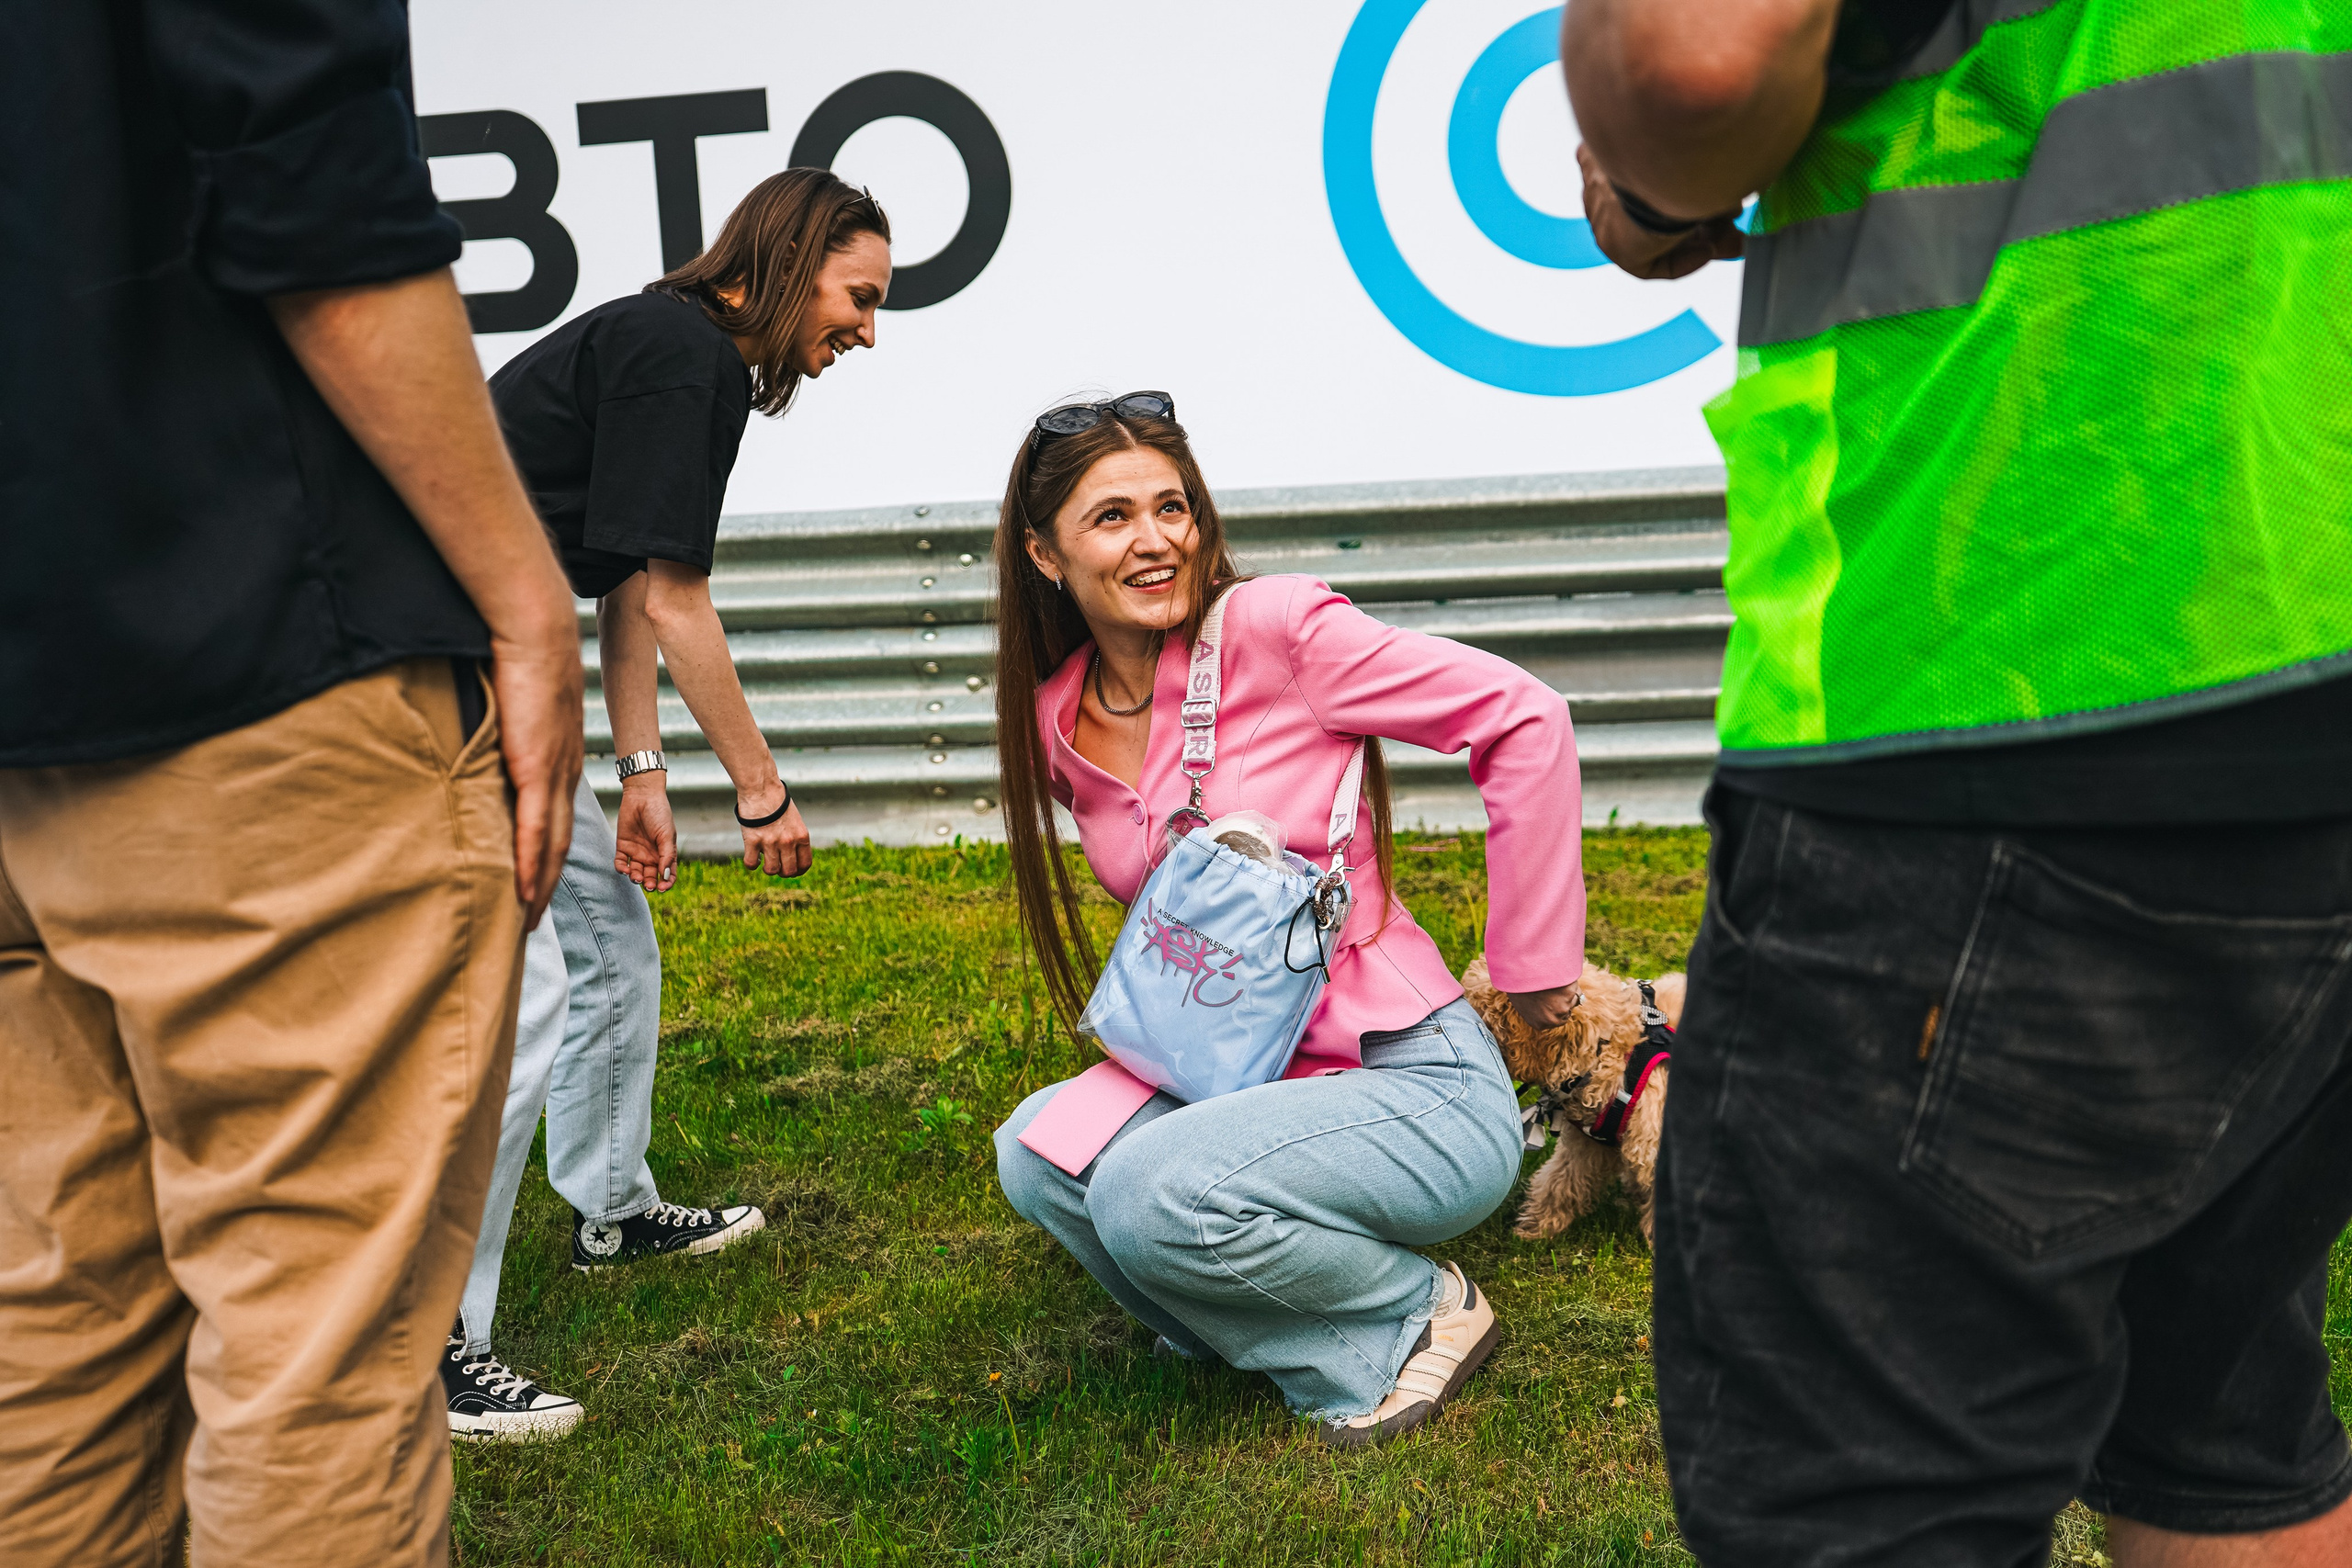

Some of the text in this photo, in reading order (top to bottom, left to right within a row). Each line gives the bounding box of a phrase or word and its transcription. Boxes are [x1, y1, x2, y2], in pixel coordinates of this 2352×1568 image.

[1157, 908, 1235, 957] A SECRET KNOWLEDGE
